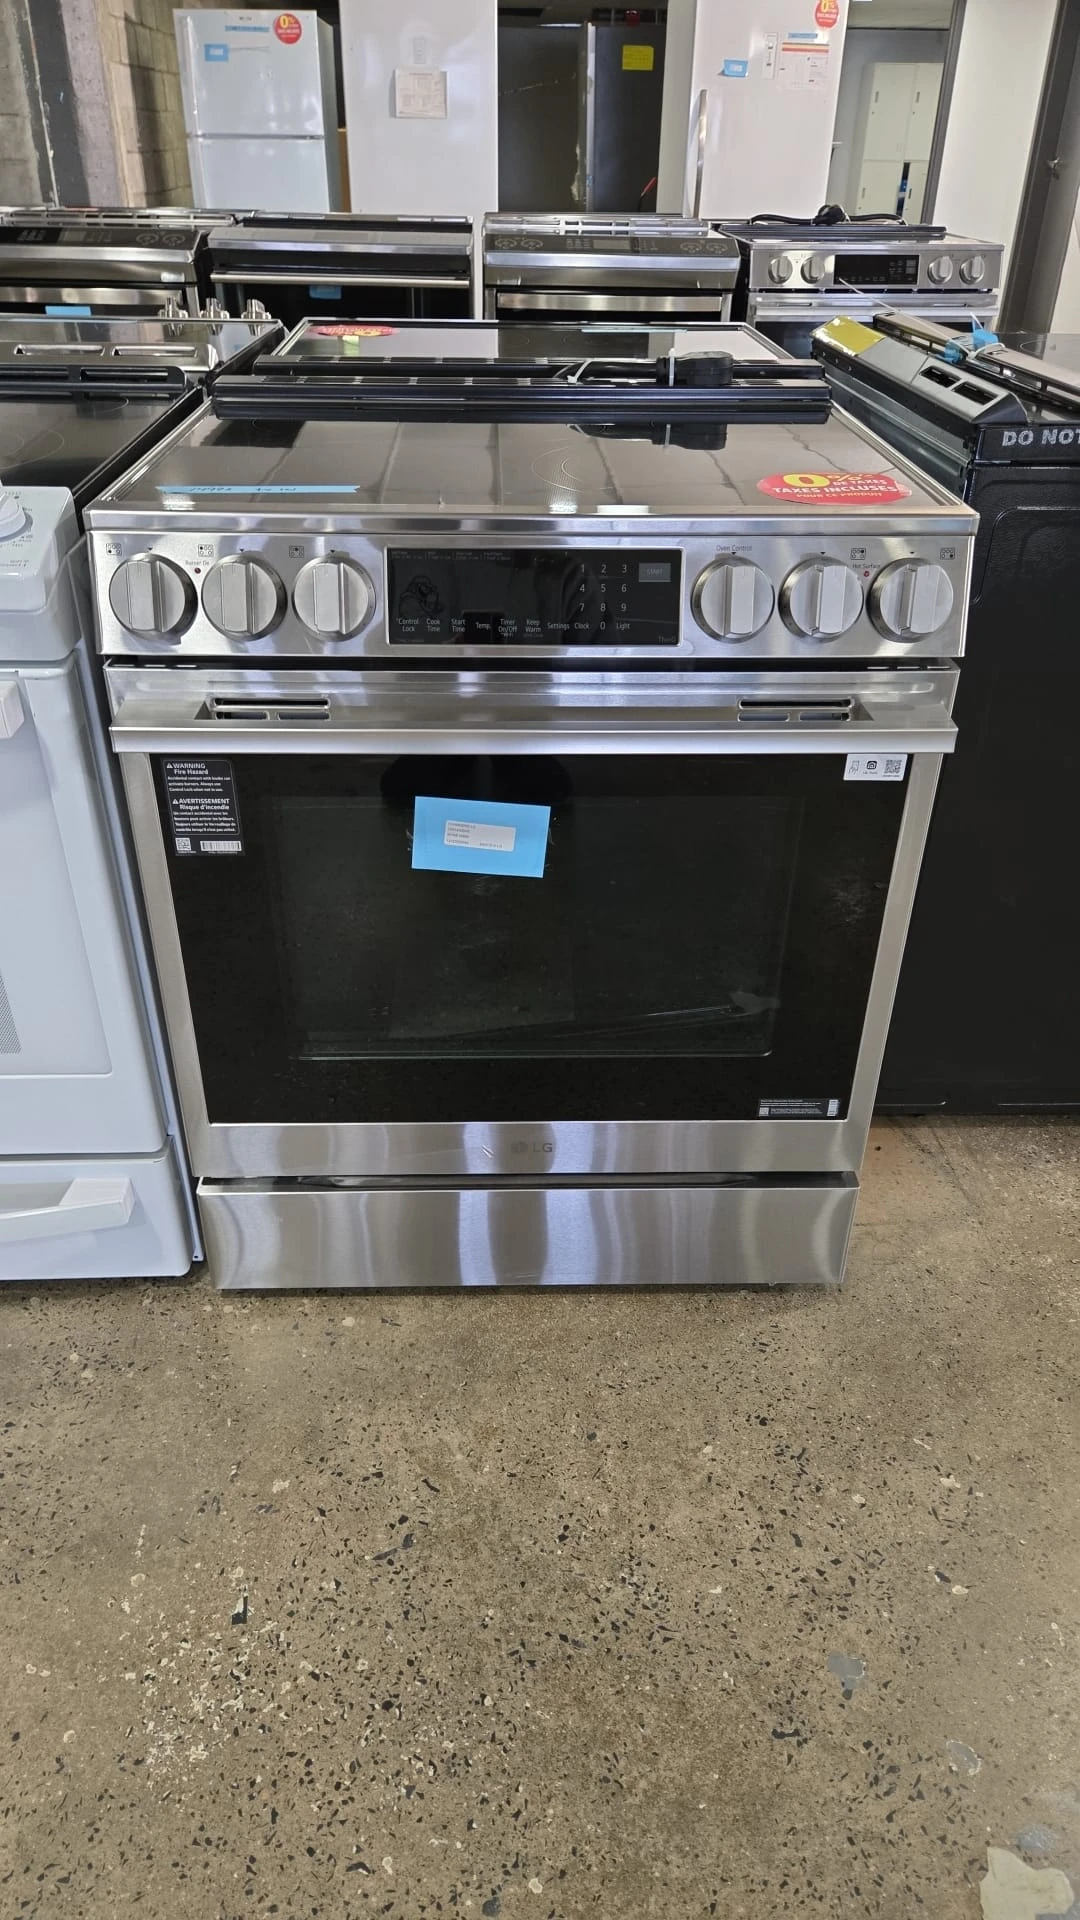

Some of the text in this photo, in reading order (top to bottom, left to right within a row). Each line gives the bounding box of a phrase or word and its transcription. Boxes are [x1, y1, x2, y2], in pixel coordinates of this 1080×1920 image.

[1002, 430, 1034, 447] DO
[824, 485, 898, 493] INCLUSES
[601, 564, 607, 573] 2
[622, 564, 627, 573] 3
[580, 584, 627, 592] 4 5 6
[580, 603, 627, 612] 7 8 9
[547, 622, 570, 630] Settings
[616, 622, 631, 630] Light
[533, 1142, 553, 1153] LG
